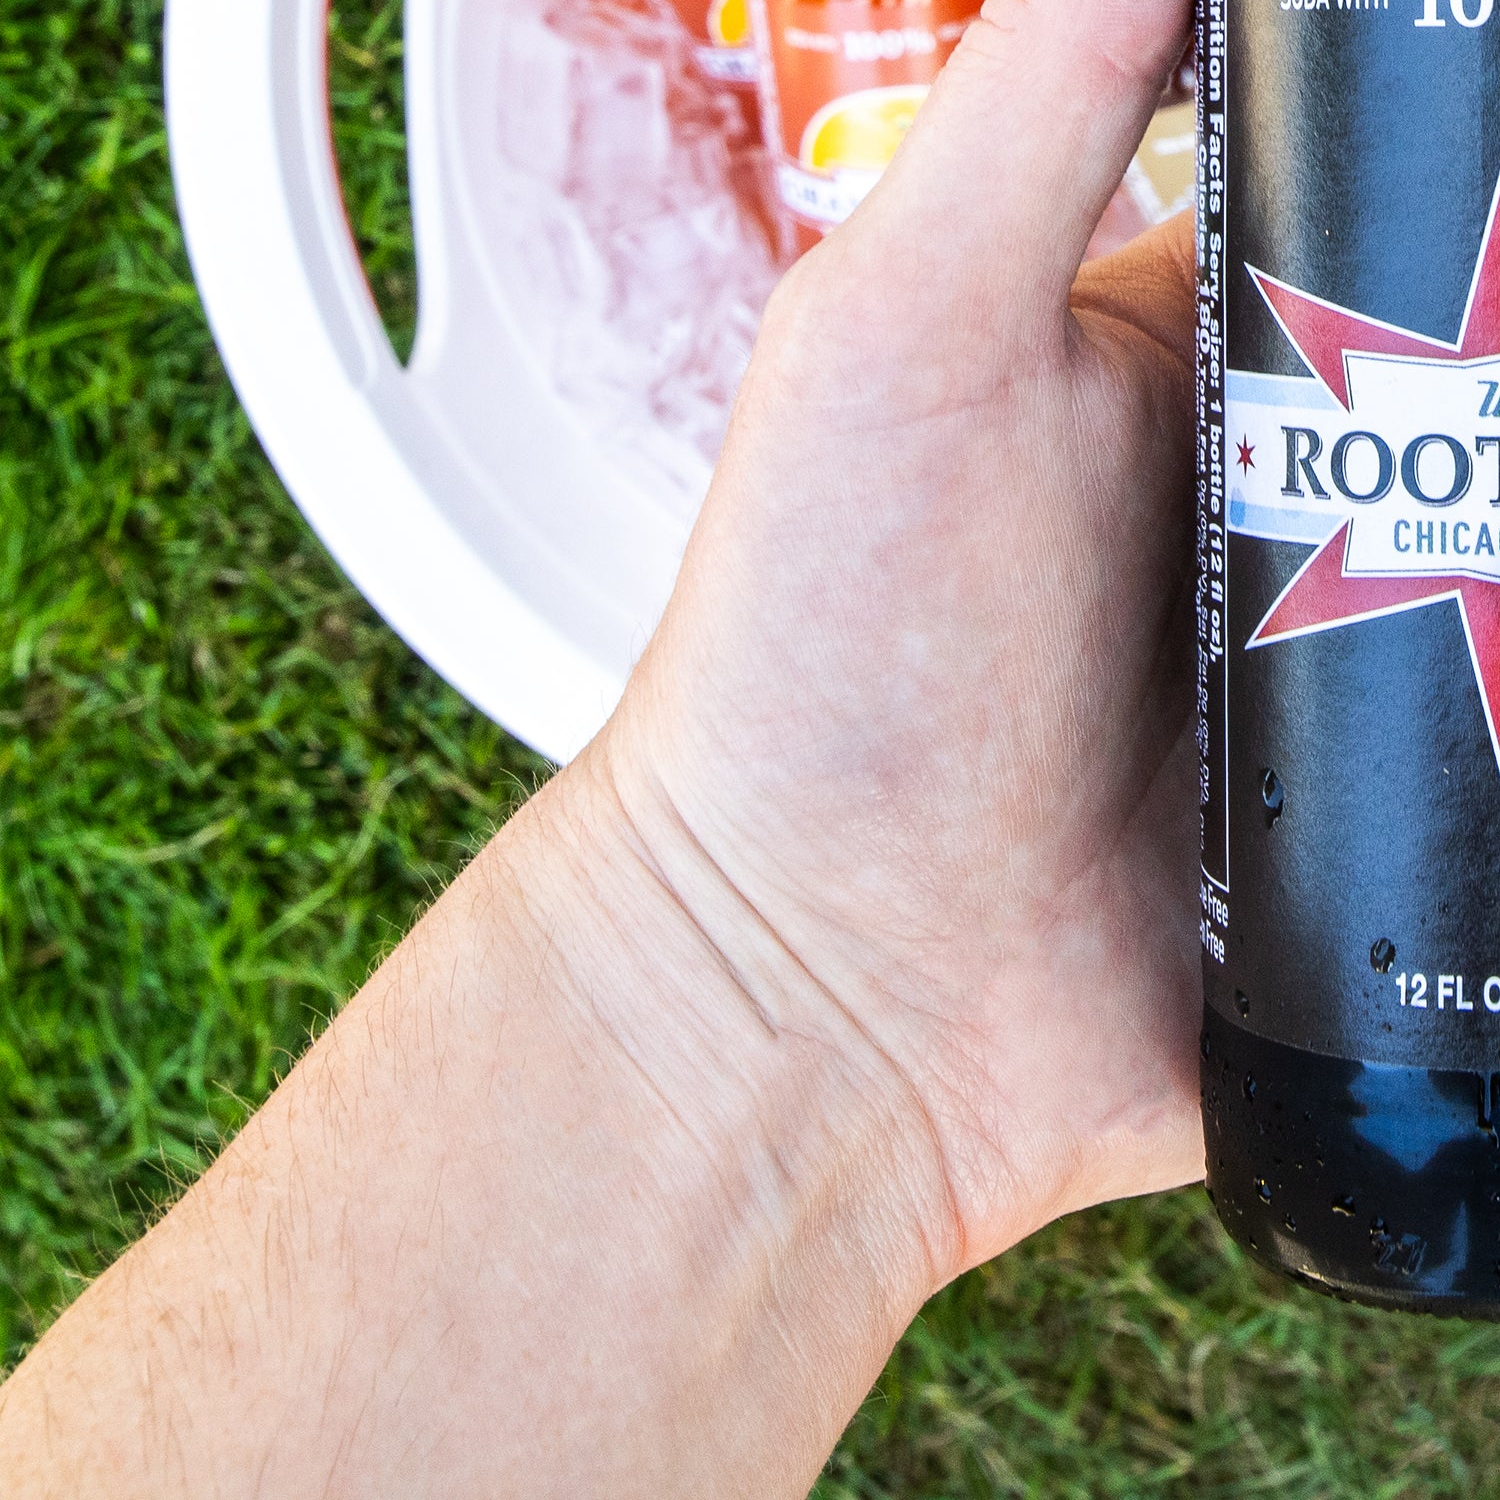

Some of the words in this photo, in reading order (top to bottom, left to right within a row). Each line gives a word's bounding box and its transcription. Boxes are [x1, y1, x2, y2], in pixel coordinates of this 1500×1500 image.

[1197, 24, 1205, 55] per
[1197, 62, 1206, 139] serving:
[1209, 113, 1224, 214] Facts
[1199, 143, 1207, 267] Calories
[1209, 232, 1222, 309] Serv.
[1209, 317, 1222, 388] size:
[1210, 399, 1222, 413] 1
[1210, 424, 1223, 515] bottle
[1209, 522, 1223, 574] (12
[1211, 579, 1223, 603] fl
[1209, 609, 1223, 663] oz),
[1207, 883, 1229, 928] Free
[1206, 919, 1225, 964] Free
[1395, 973, 1428, 1009] 12
[1437, 975, 1474, 1011] FL
